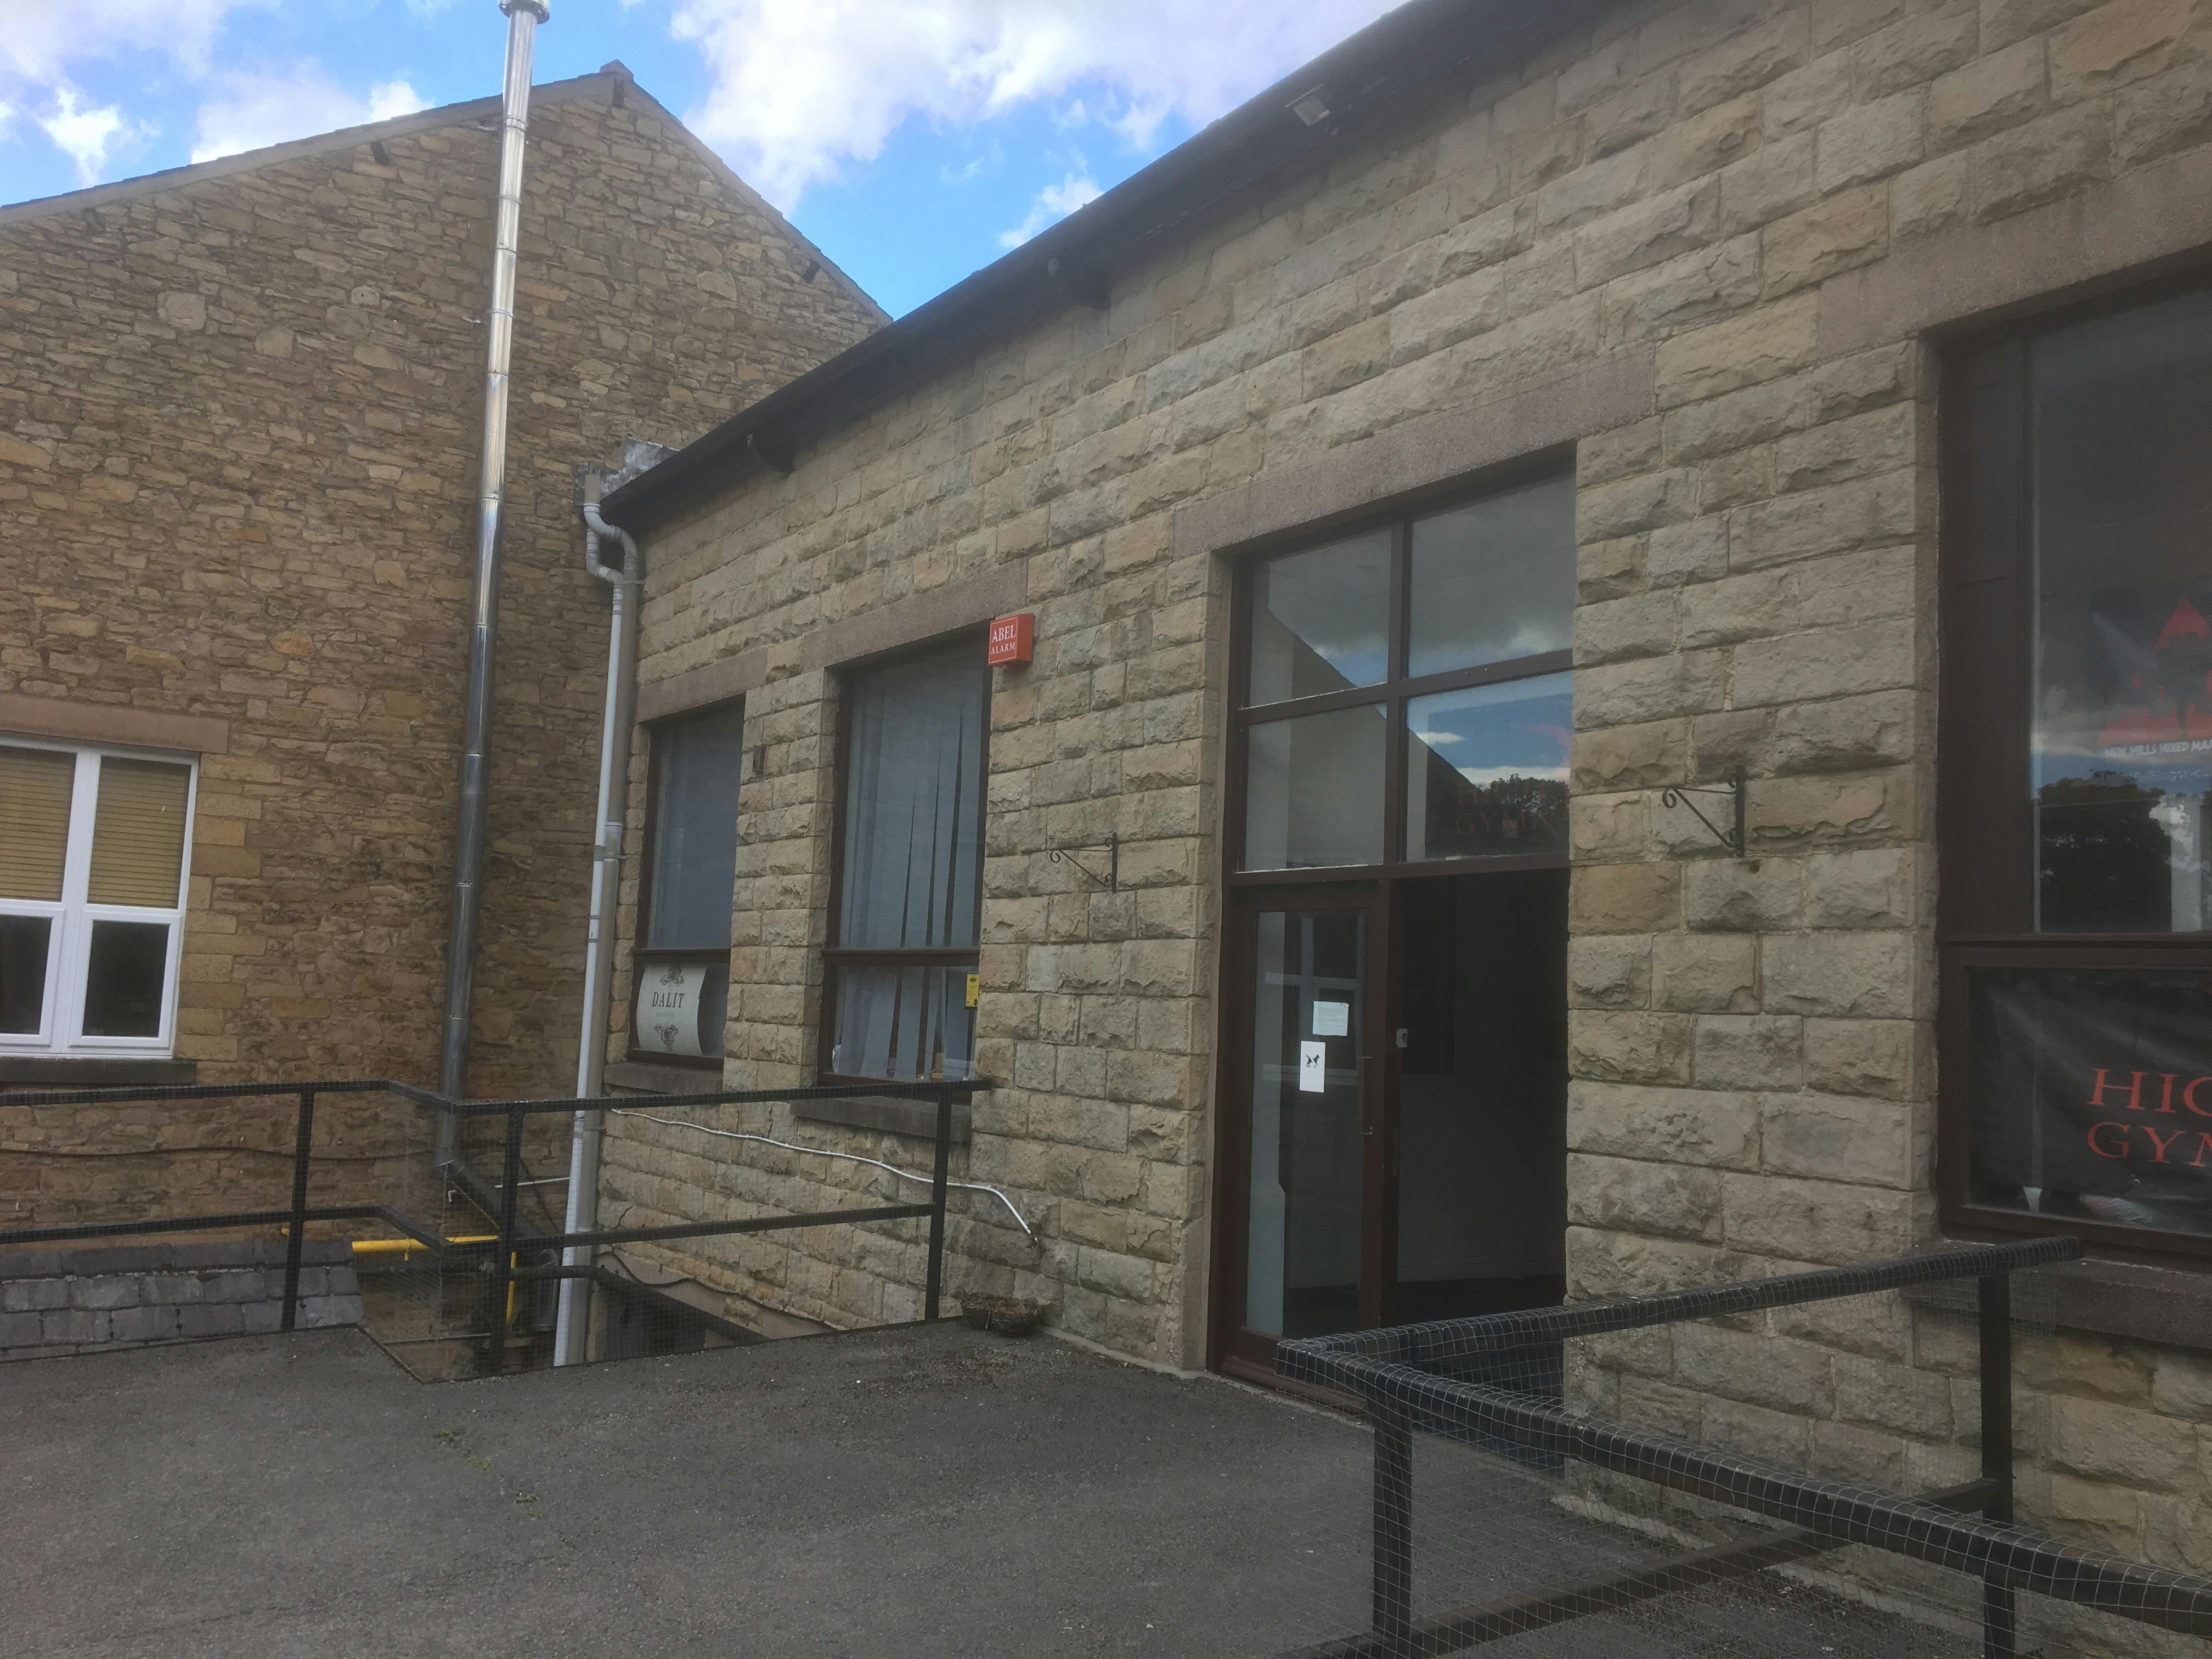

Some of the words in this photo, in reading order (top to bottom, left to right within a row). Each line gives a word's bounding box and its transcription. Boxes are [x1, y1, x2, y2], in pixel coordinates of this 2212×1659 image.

[992, 625, 1016, 642] ABEL
[991, 642, 1015, 655] ALARM
[2159, 742, 2190, 754] MIXED
[652, 992, 685, 1008] DALIT
